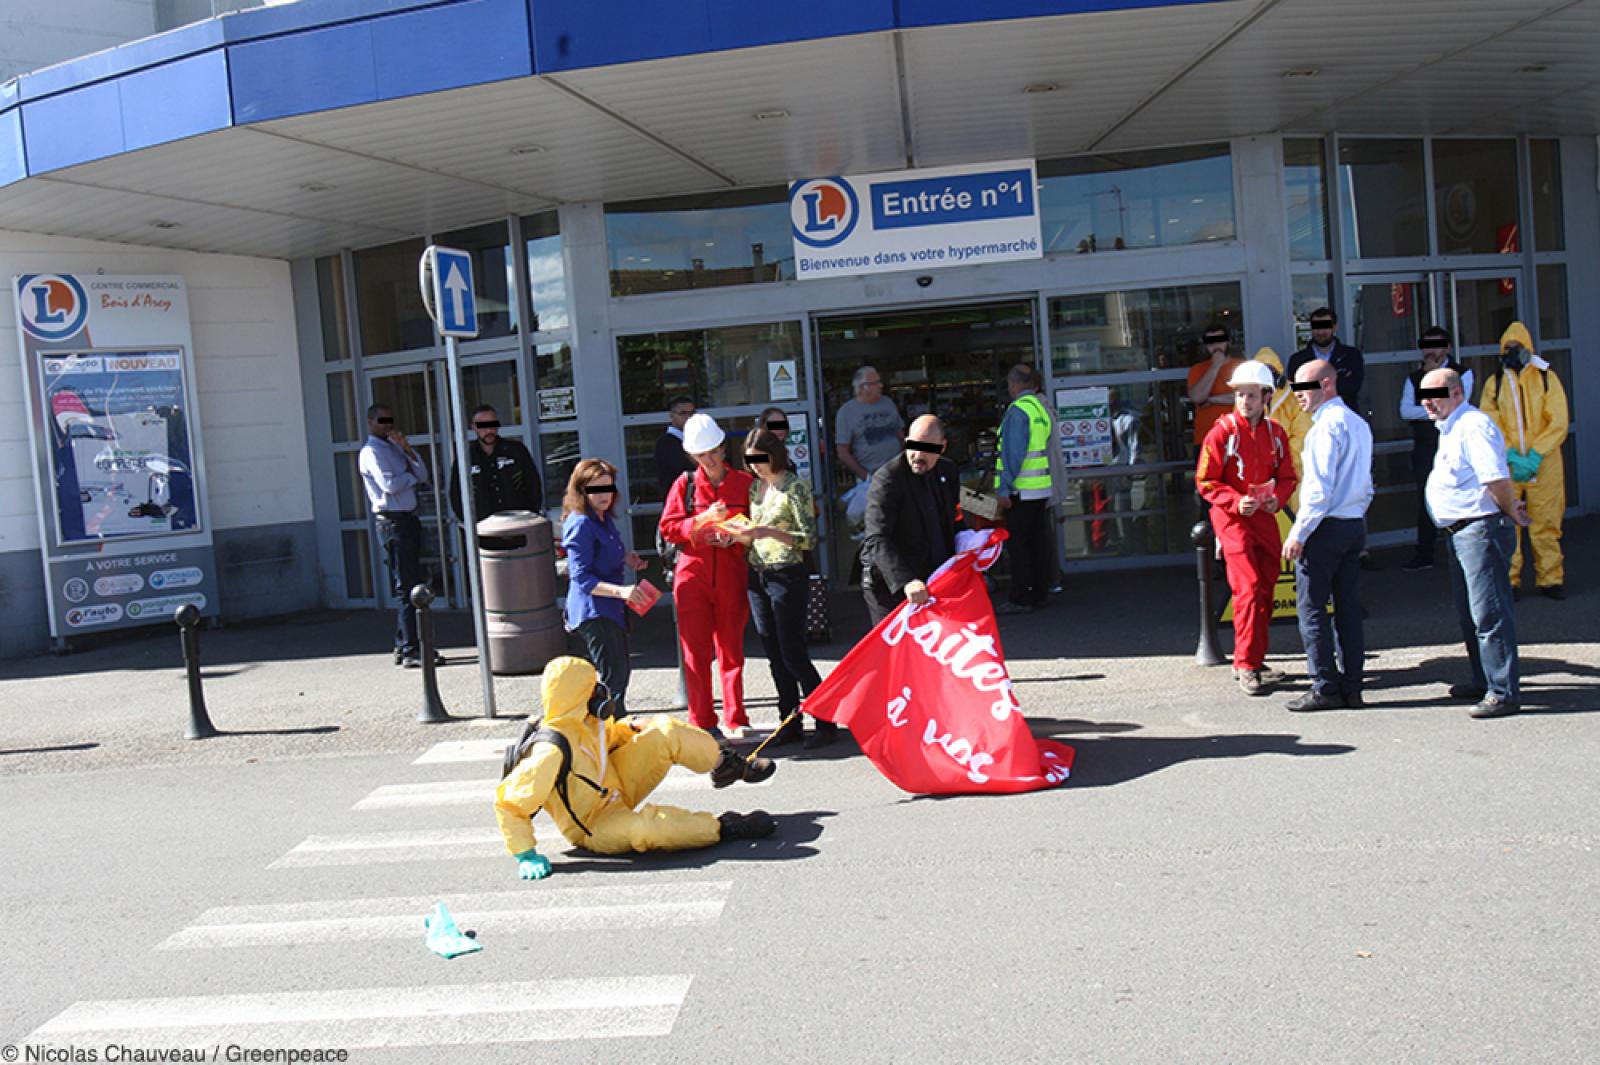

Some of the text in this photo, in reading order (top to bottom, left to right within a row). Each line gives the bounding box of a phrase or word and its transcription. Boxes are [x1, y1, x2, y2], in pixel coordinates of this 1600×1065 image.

[802, 192, 836, 232] L
[882, 181, 1024, 217] Entrée n°1
[800, 238, 1037, 271] Bienvenue dans votre hypermarché
[91, 282, 180, 290] CENTRE COMMERCIAL
[32, 286, 65, 324] L
[101, 293, 172, 312] Bois d'Arcy
[109, 357, 176, 370] NOUVEAU
[96, 558, 132, 570] VOTRE
[134, 553, 177, 566] SERVICE
[1274, 599, 1296, 610] DAN
[881, 596, 1022, 721] faites
